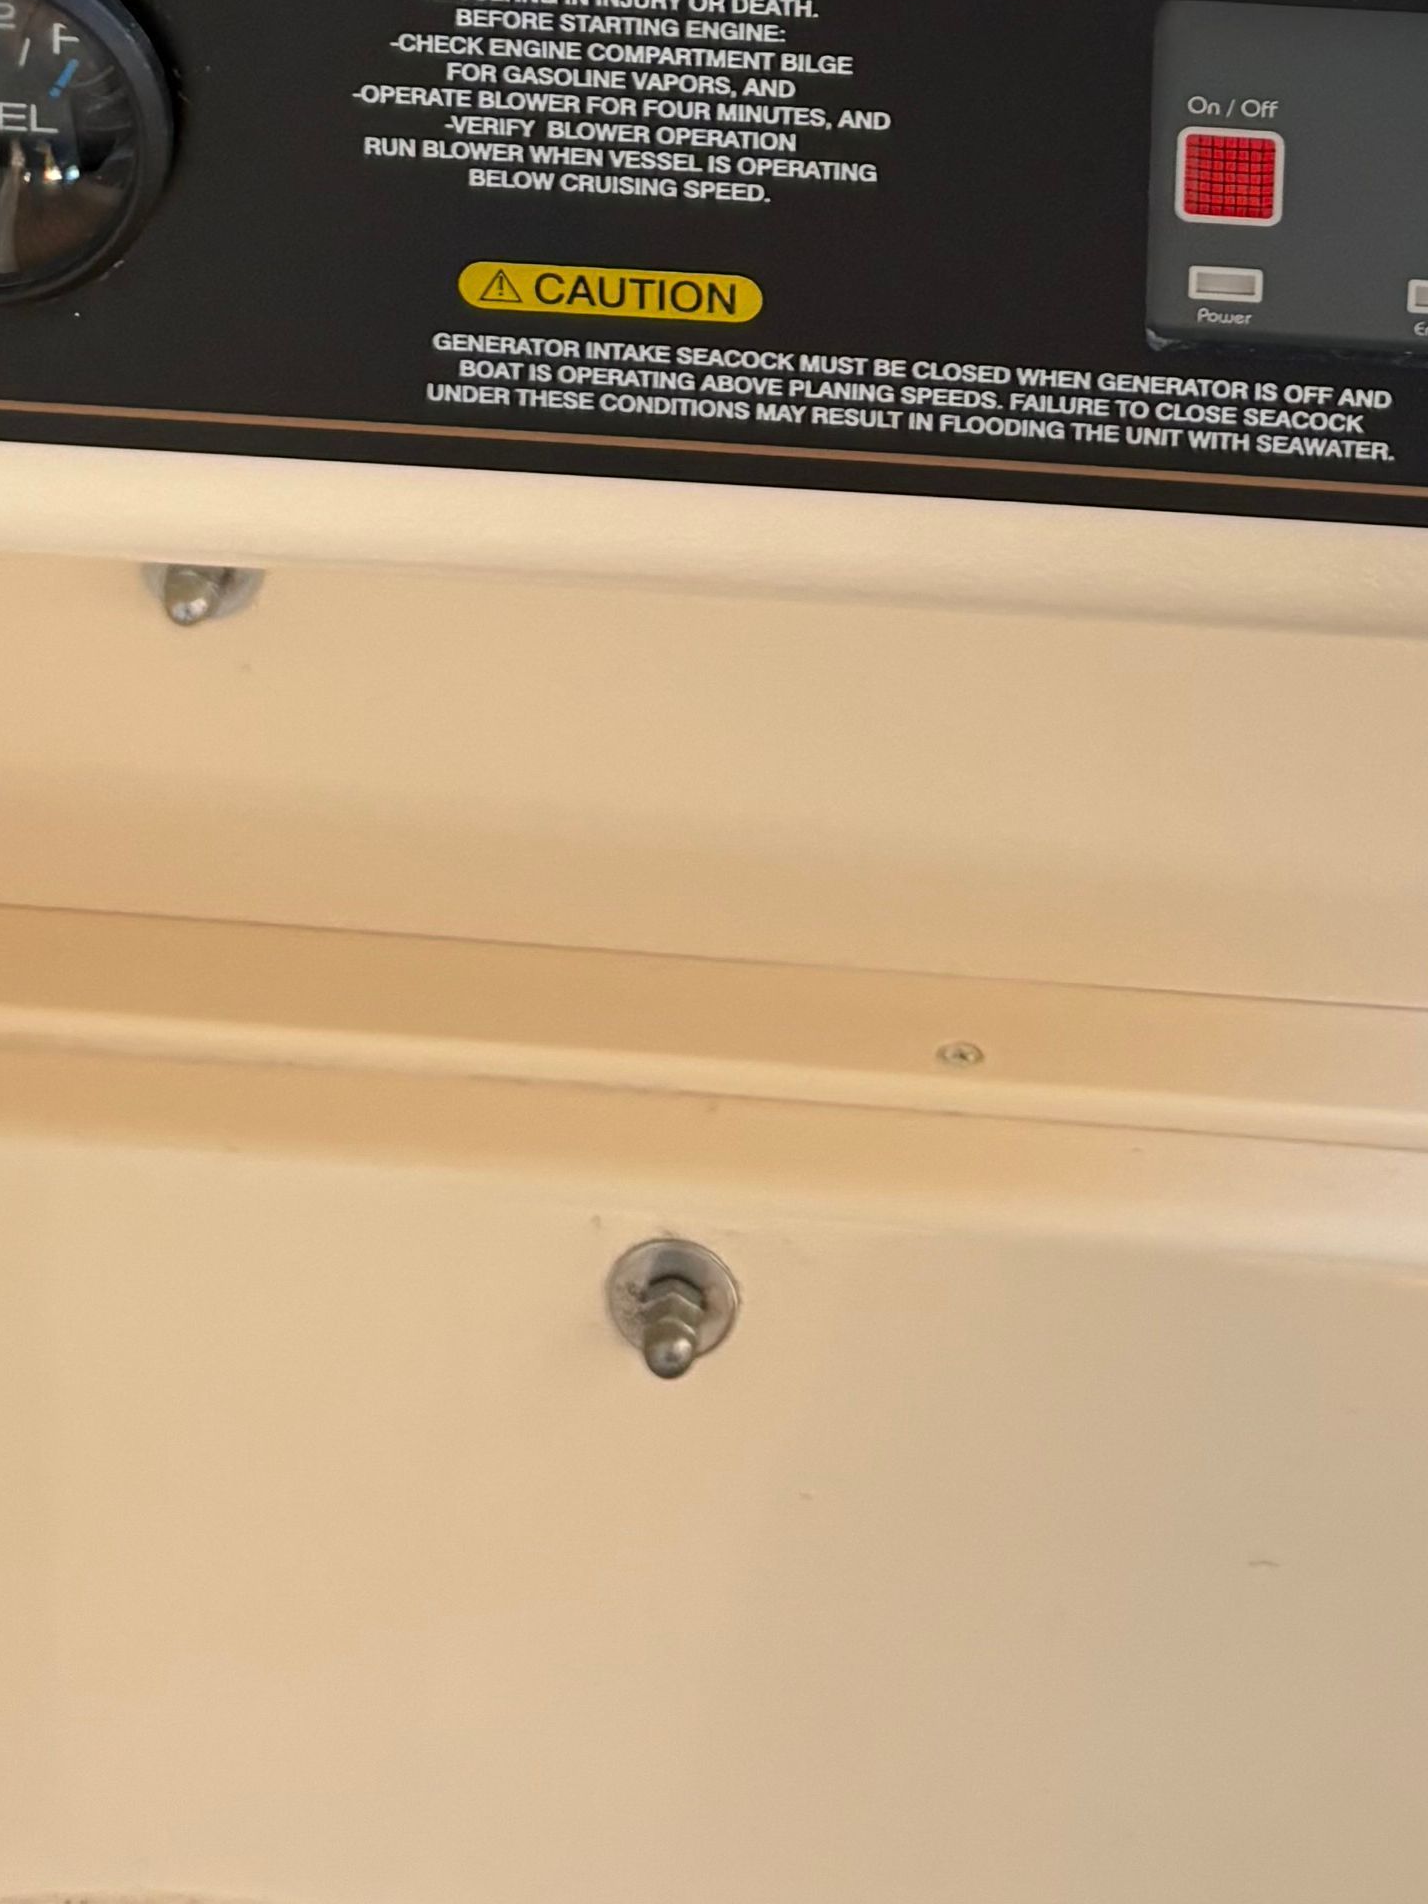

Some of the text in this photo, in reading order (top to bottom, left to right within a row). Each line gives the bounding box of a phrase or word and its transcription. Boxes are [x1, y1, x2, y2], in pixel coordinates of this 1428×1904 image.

[1188, 96, 1220, 115] On
[1241, 100, 1278, 117] Off
[533, 275, 739, 316] CAUTION
[1198, 308, 1252, 324] Power
